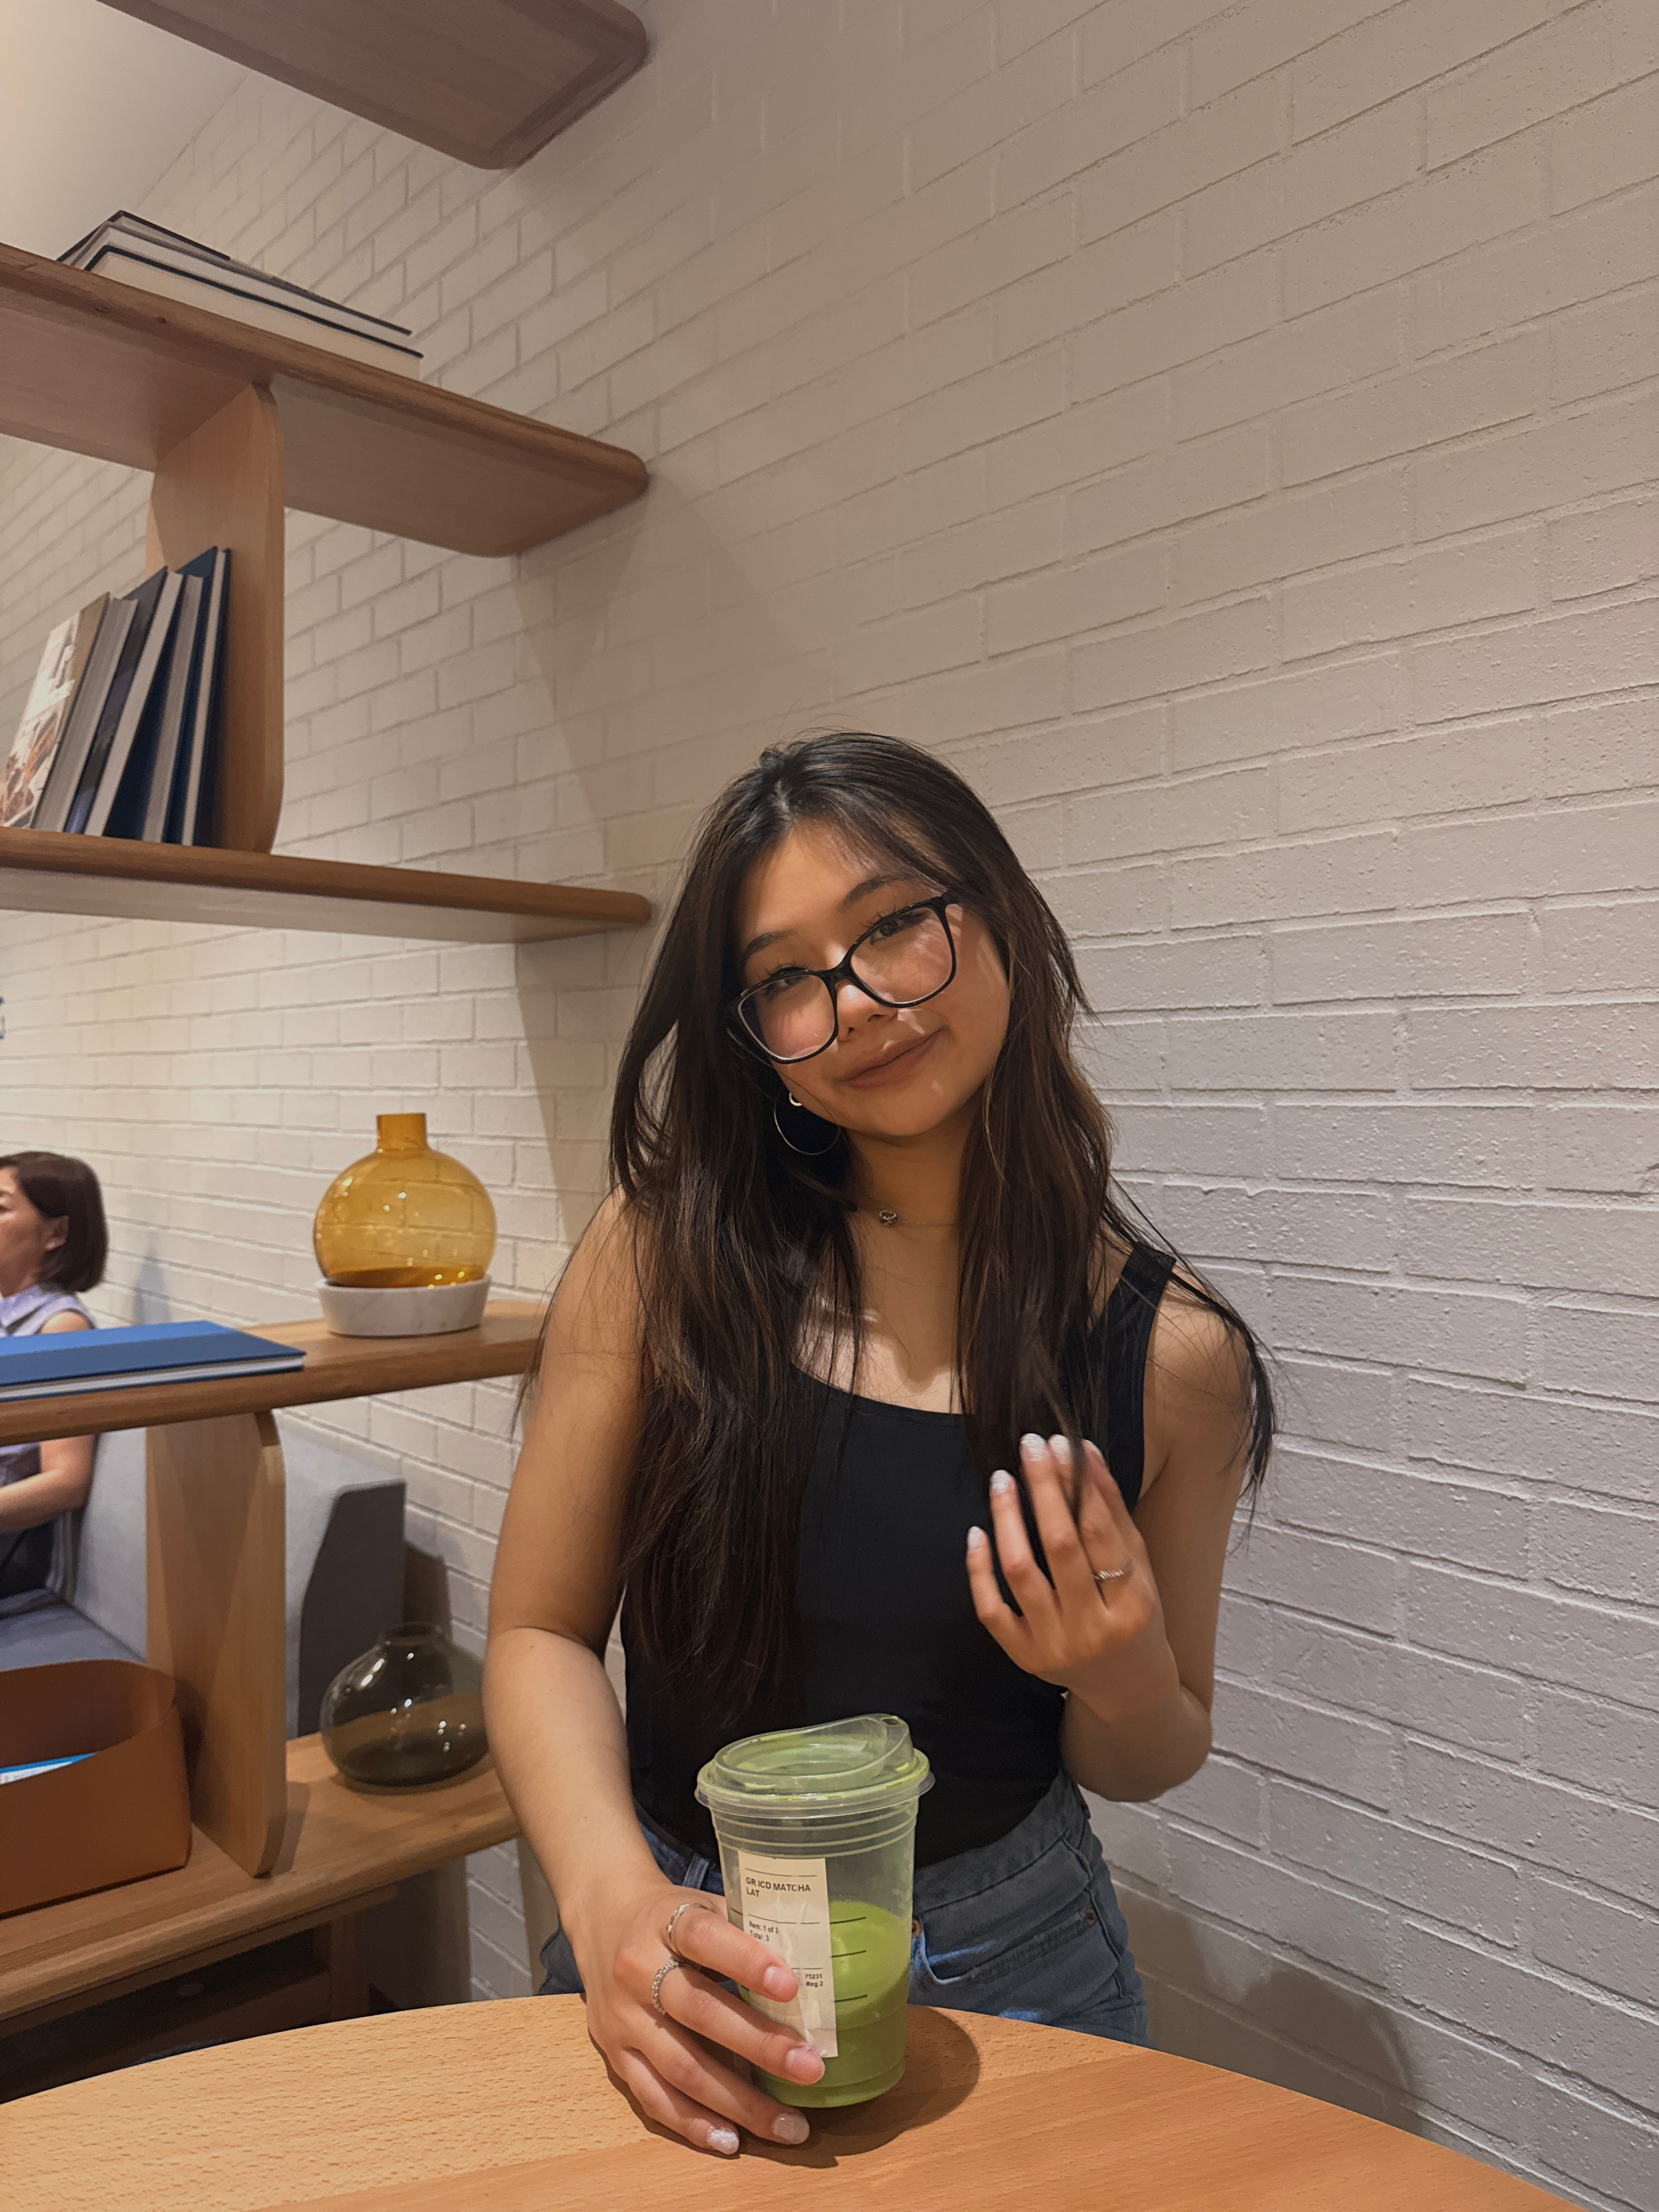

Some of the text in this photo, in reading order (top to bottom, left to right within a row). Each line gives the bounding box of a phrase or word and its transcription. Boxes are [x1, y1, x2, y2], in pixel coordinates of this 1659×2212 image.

[746, 1877, 811, 1892] GR ICD MATCHA
[746, 1887, 760, 1897] LAT
